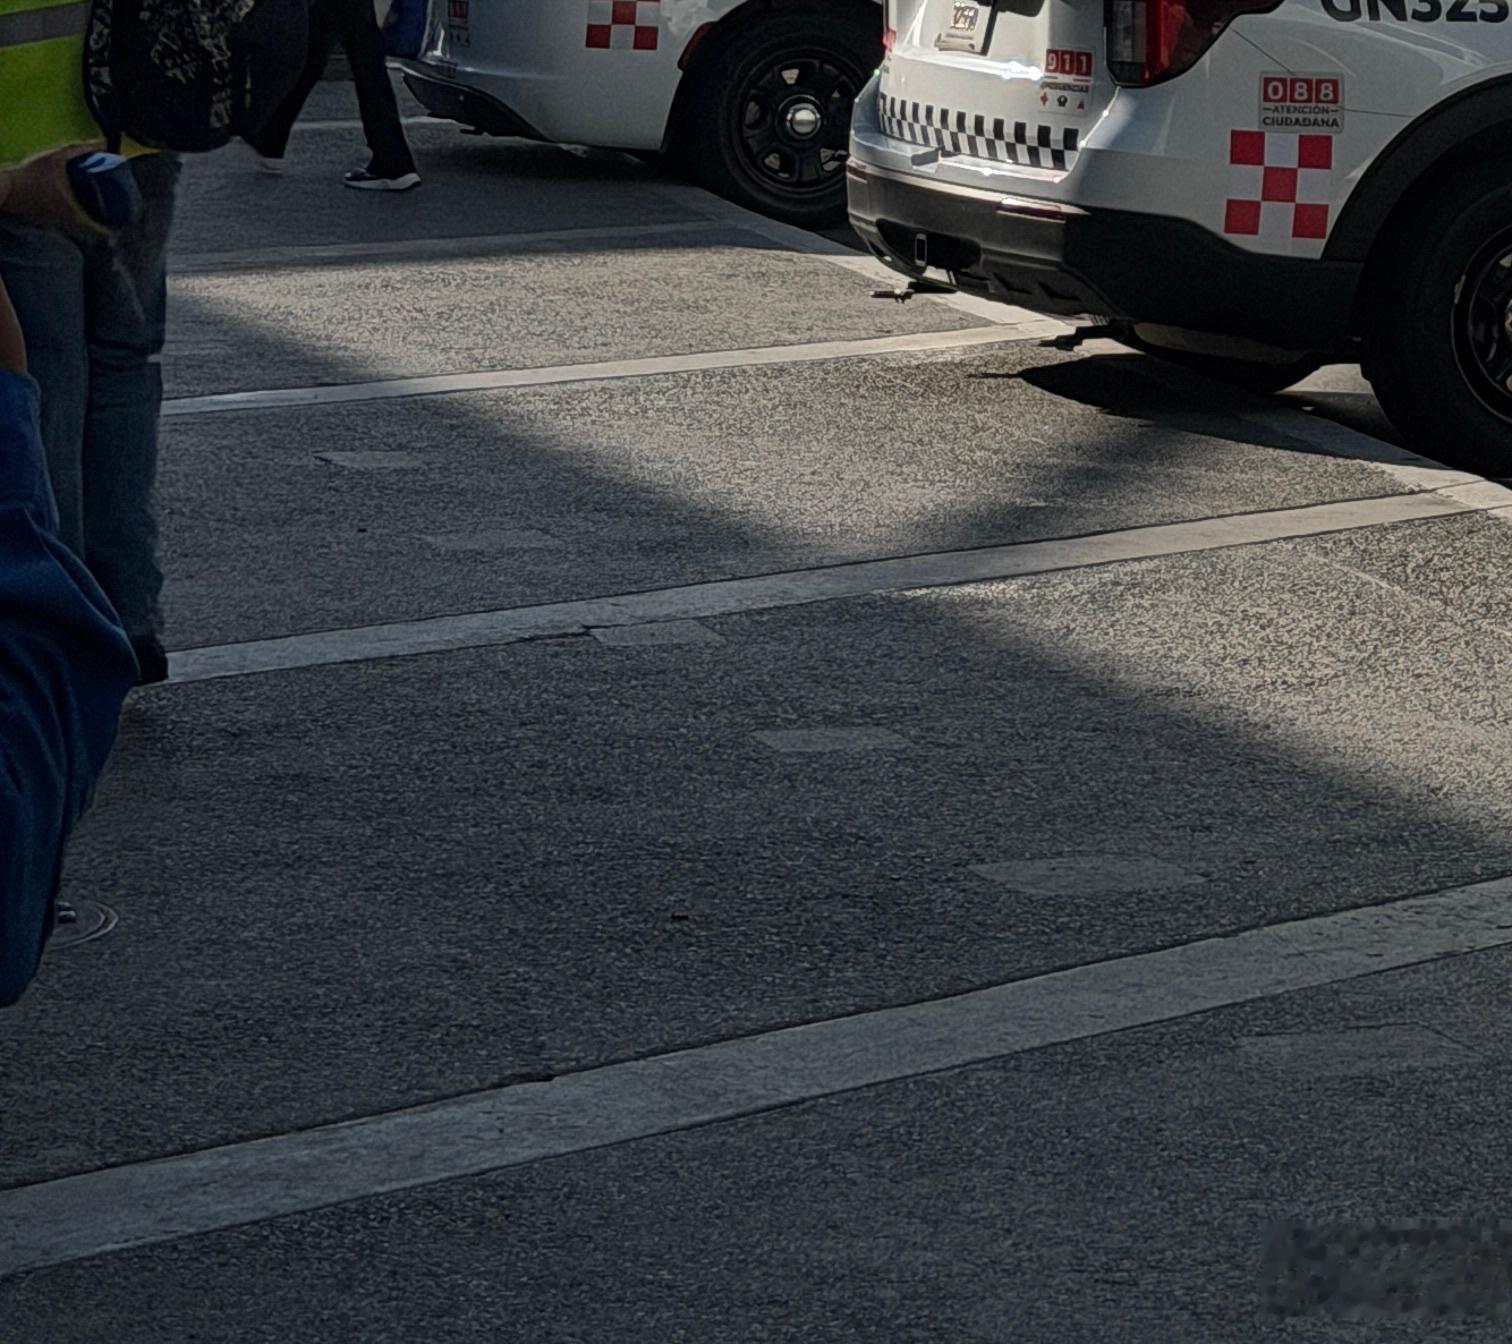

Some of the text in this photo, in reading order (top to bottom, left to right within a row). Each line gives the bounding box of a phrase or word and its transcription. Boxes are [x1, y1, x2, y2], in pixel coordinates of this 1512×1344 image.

[1047, 53, 1087, 74] 911
[1267, 81, 1333, 101] 088
[1262, 116, 1340, 128] CIUDADANA
